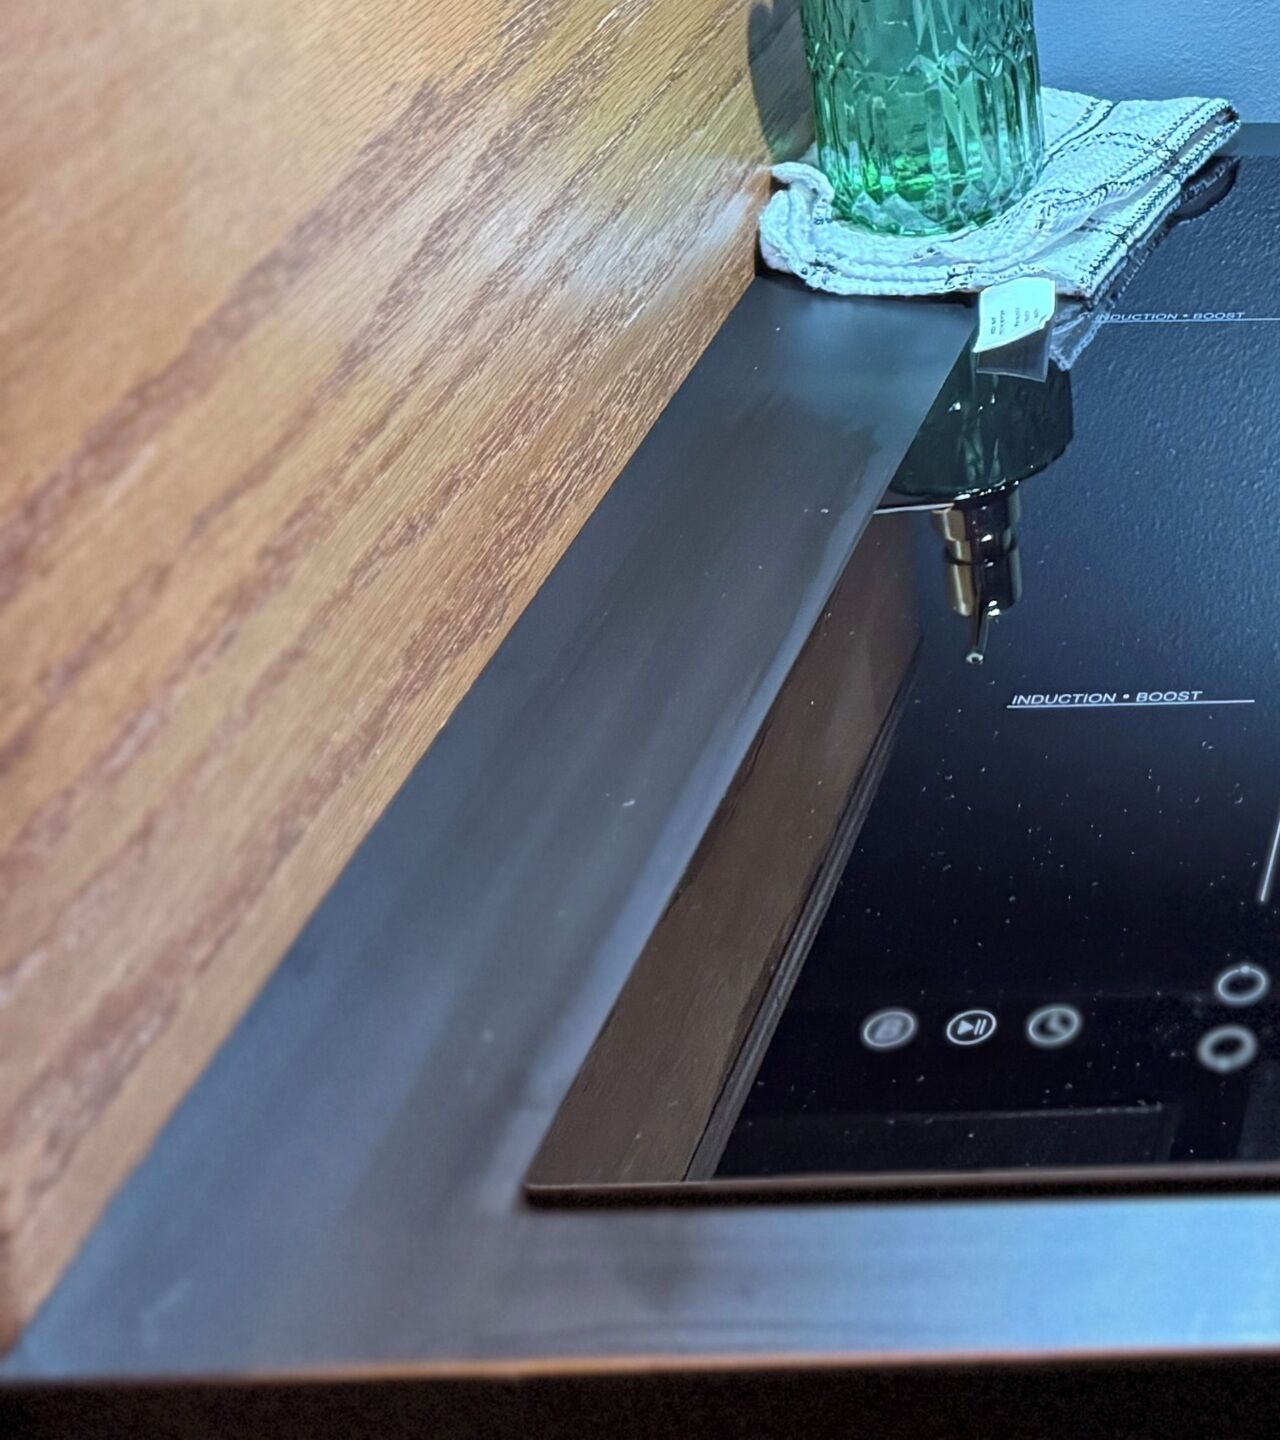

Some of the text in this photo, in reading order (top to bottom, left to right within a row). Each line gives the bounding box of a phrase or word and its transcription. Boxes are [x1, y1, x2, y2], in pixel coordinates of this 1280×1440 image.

[1193, 312, 1245, 321] BOOST
[1012, 690, 1203, 705] INDUCTION BOOST
